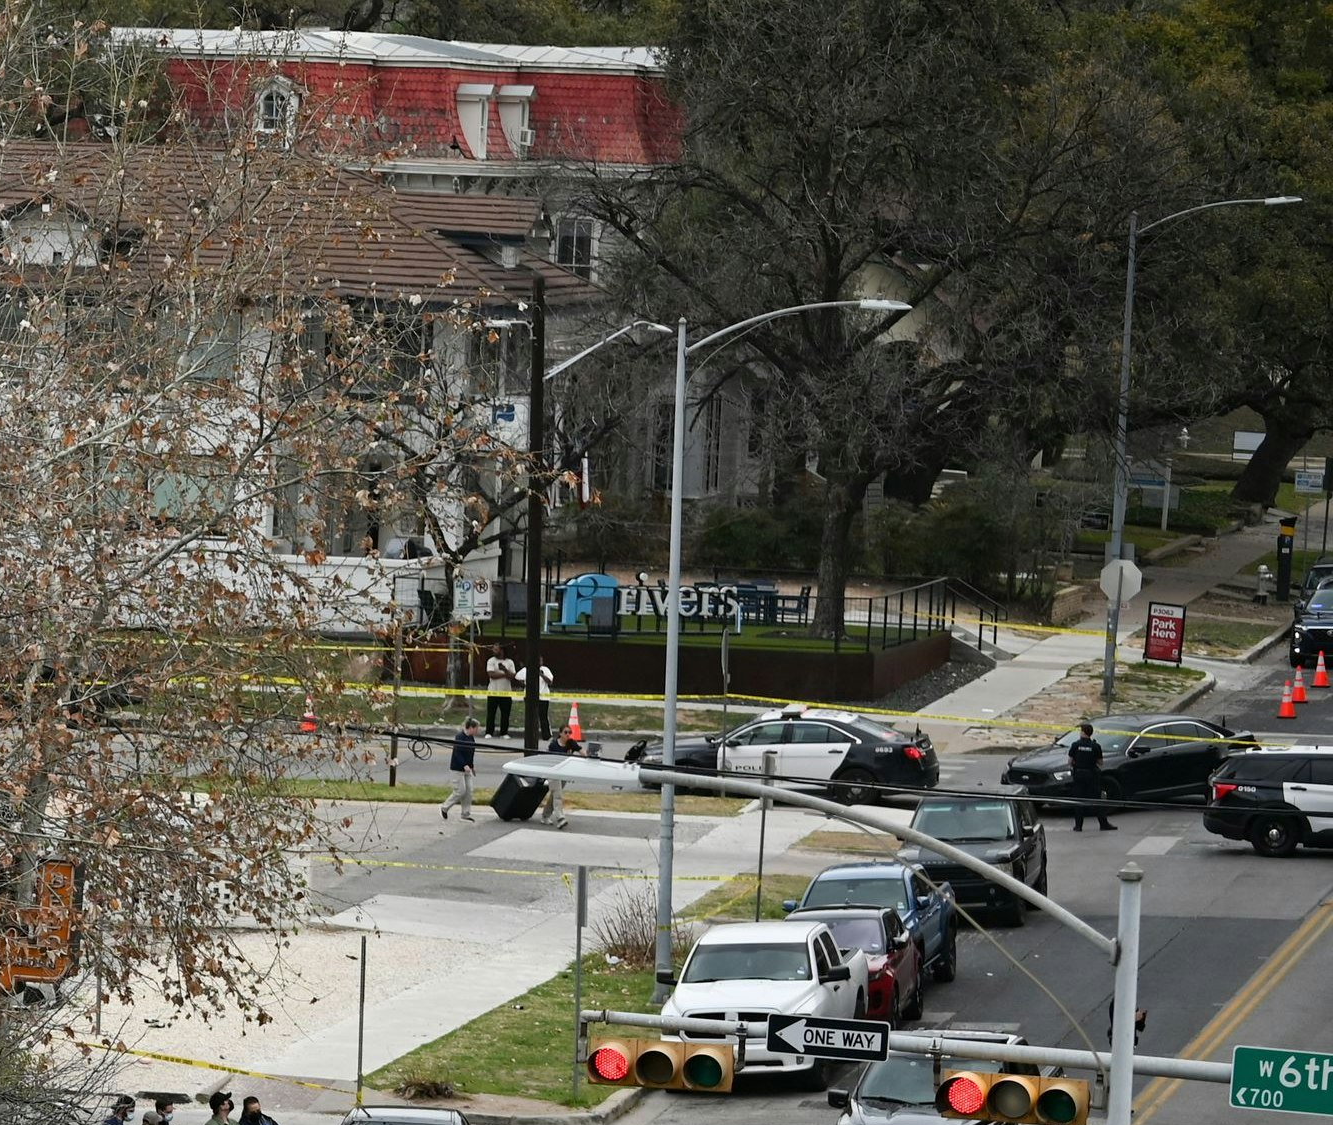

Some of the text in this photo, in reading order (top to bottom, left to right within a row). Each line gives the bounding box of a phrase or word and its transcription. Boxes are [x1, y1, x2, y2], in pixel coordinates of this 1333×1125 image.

[1152, 618, 1176, 630] Park
[1151, 627, 1176, 639] Here
[804, 1029, 875, 1048] ONE WAY
[1259, 1060, 1274, 1077] W
[1250, 1089, 1283, 1108] 700
